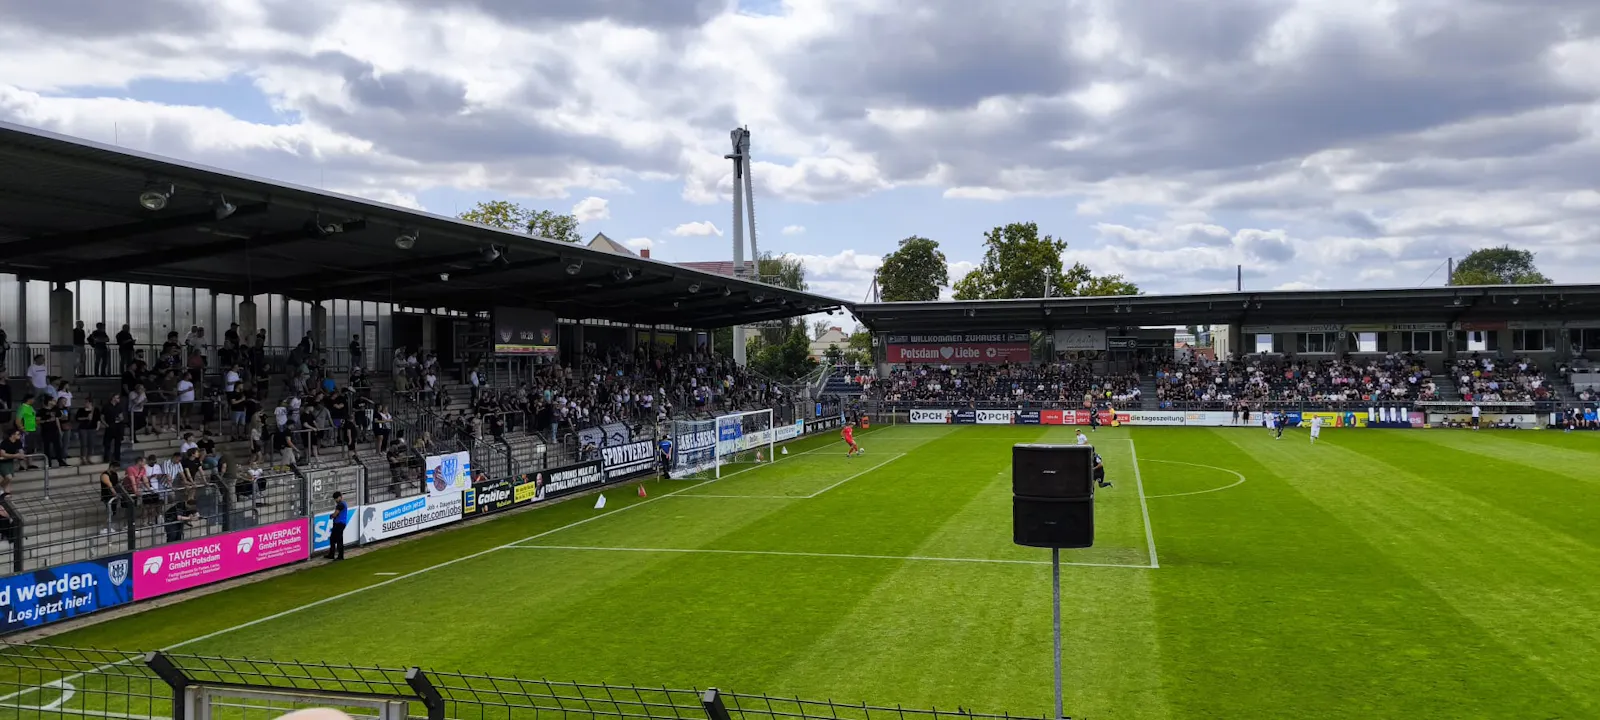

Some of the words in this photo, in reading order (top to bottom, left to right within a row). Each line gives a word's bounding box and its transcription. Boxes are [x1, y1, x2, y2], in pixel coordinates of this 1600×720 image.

[910, 334, 963, 343] WILLKOMMEN
[900, 348, 939, 359] Potsdam
[955, 347, 980, 358] Liebe
[921, 412, 942, 420] PCH
[988, 413, 1009, 421] PCH
[1141, 415, 1184, 423] tageszeitung
[602, 440, 654, 467] SPORTVEREIN
[550, 472, 562, 482] WHO
[562, 469, 578, 481] DRINKS
[545, 480, 567, 493] FOOTBALL
[567, 477, 582, 489] MATCH
[478, 489, 511, 505] Gabler
[402, 503, 411, 515] dich
[427, 503, 436, 513] Job
[382, 504, 462, 531] superberater.com/jobs
[258, 525, 302, 543] TAVERPACK
[259, 539, 277, 551] GmbH
[278, 536, 301, 547] Potsdam
[168, 542, 221, 562] TAVERPACK
[169, 557, 191, 571] GmbH
[192, 553, 220, 567] Potsdam
[17, 572, 98, 603] werden.
[8, 610, 32, 624] Los
[34, 599, 63, 620] jetzt
[65, 592, 92, 610] hier!
